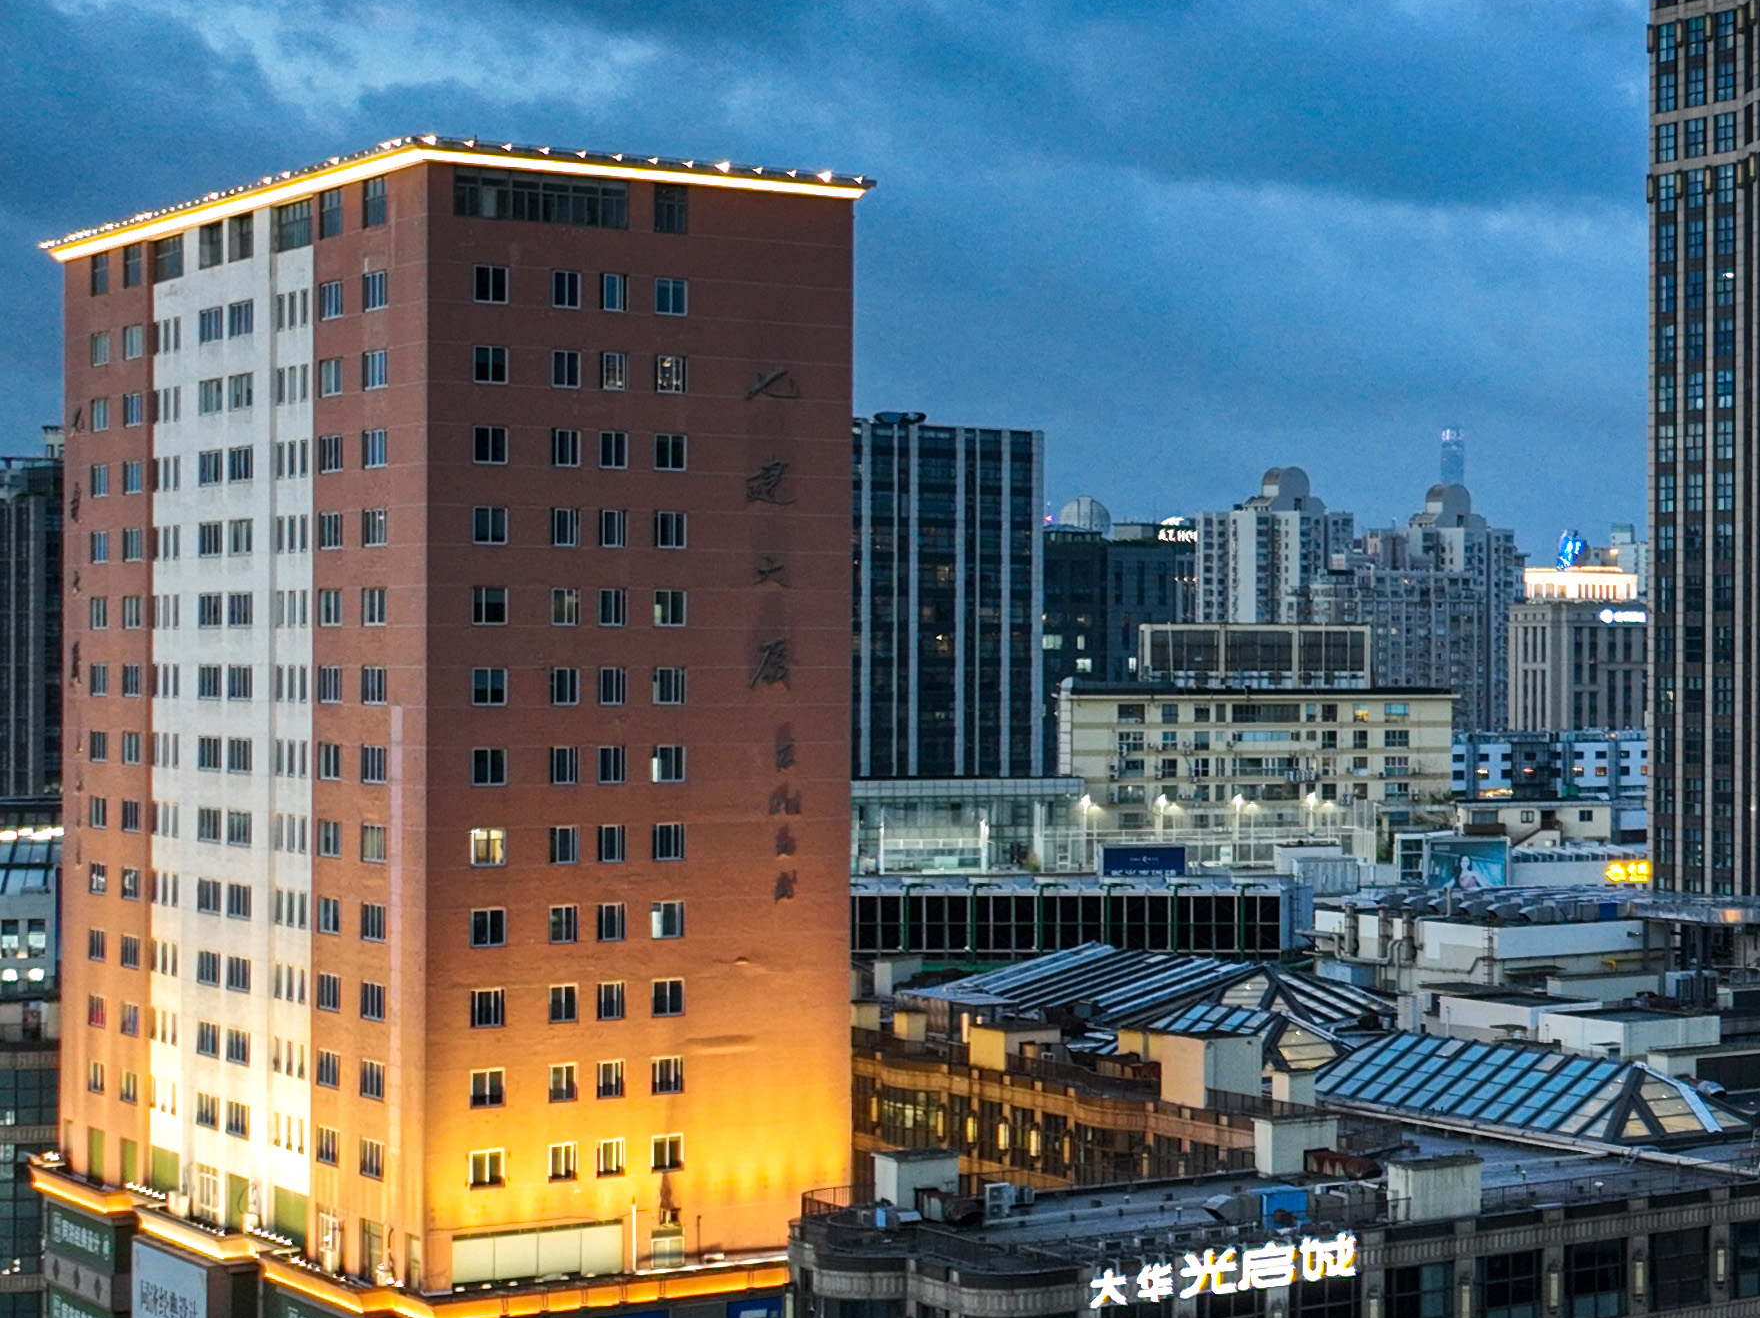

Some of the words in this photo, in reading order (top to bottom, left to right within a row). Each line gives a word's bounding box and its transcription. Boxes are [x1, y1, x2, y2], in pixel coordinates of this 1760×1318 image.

[1090, 1231, 1358, 1309] 大华光启城
